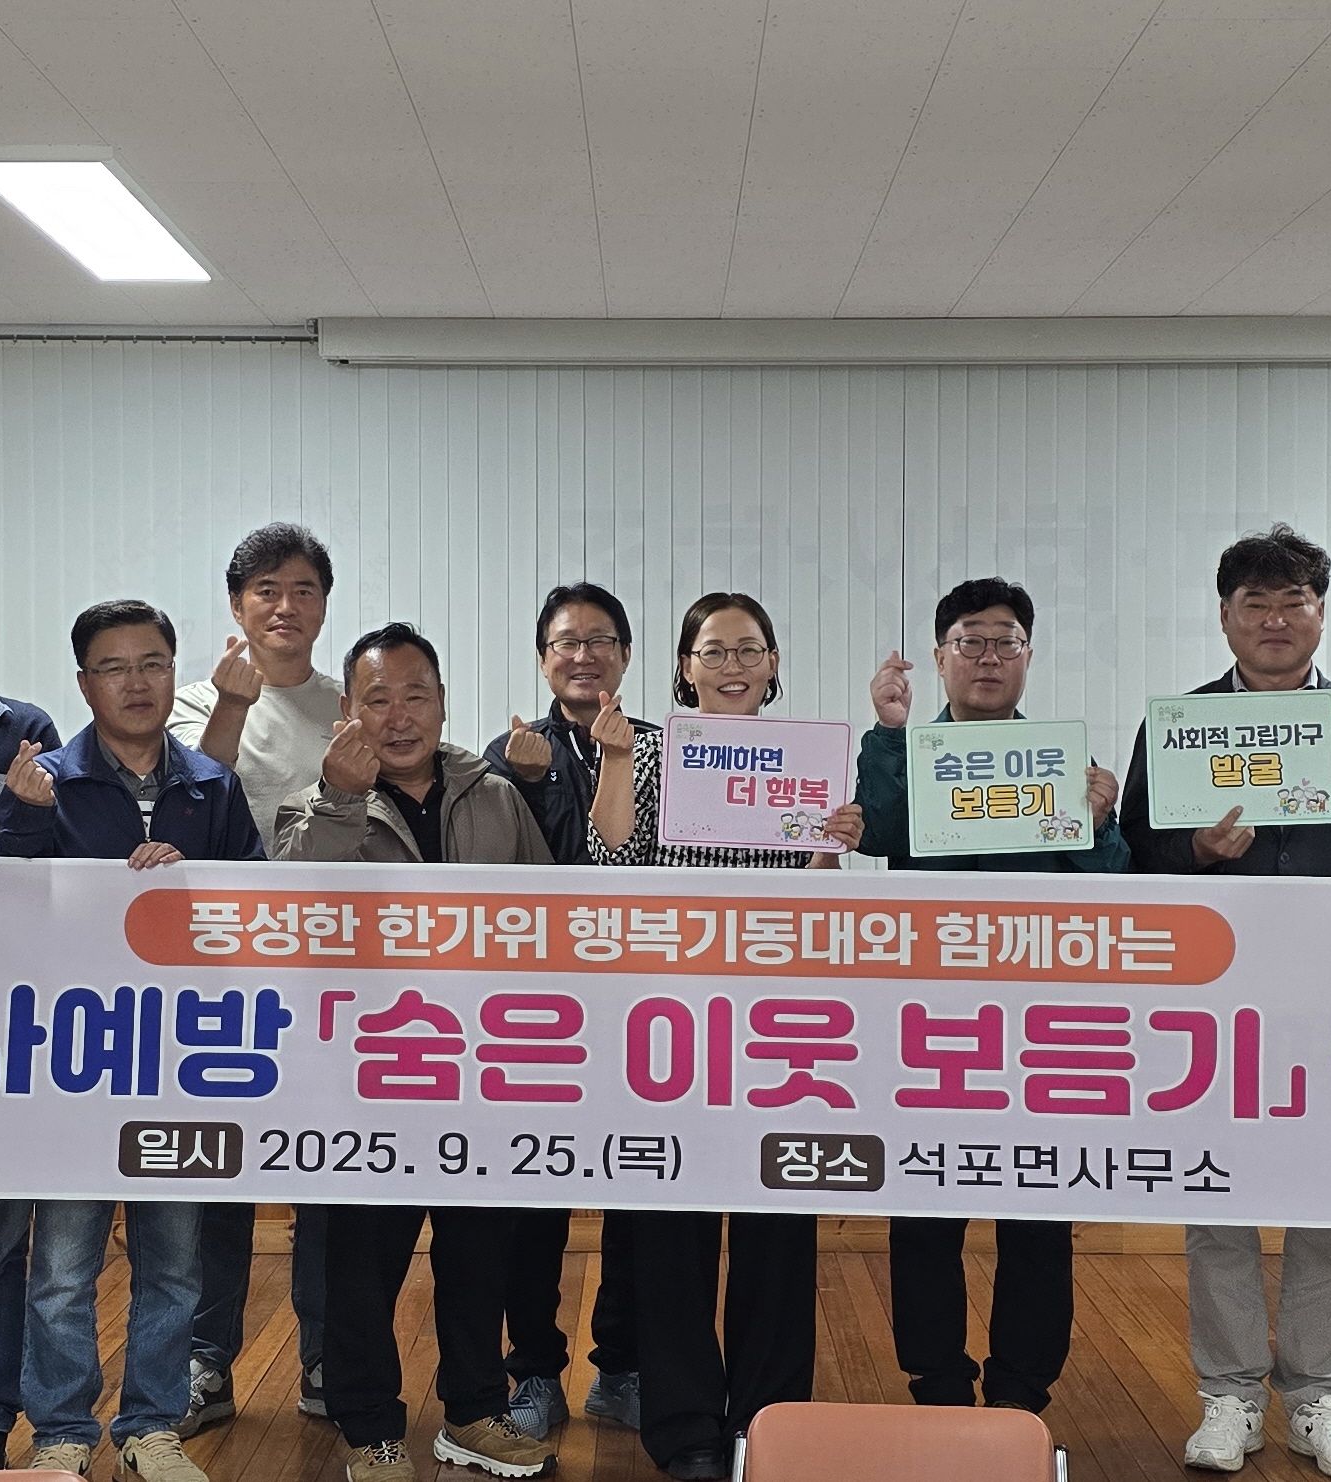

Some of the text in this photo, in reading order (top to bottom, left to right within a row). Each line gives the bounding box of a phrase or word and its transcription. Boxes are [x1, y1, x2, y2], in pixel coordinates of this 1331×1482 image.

[1163, 723, 1323, 749] 사회적 고립가구
[681, 743, 784, 773] 함께하면
[933, 748, 1066, 782] 숨은 이웃
[1210, 753, 1284, 788] 발굴
[726, 775, 830, 810] 더 행복
[950, 782, 1056, 820] 보듬기
[189, 901, 1177, 973] 풍성한 한가위 행복기동대와 함께하는
[625, 996, 859, 1110] 이웃
[136, 1129, 1231, 1194] 일시 2025. 9. 25.(목) 장소 석포면사무소
